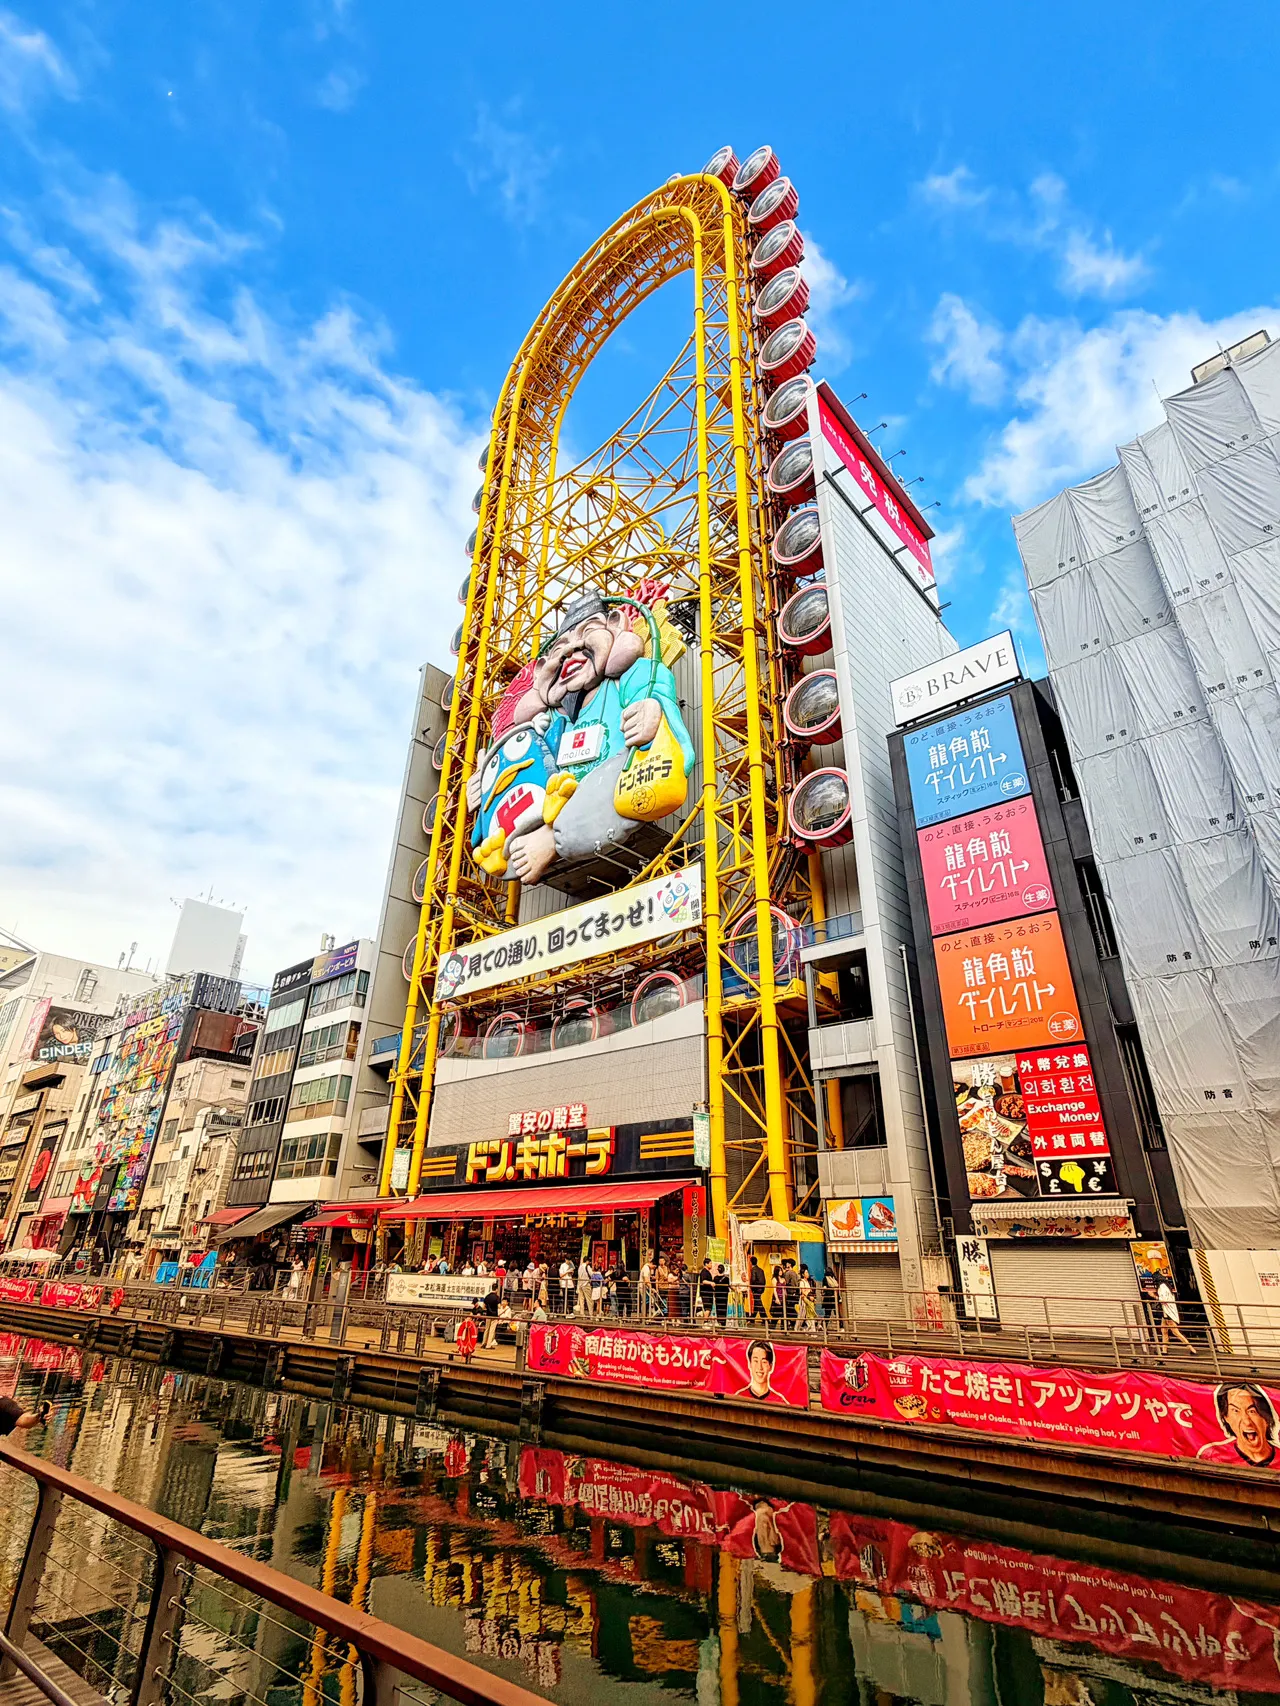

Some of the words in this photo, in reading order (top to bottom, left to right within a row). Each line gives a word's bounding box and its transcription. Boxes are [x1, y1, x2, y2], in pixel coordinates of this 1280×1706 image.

[858, 460, 902, 529] 免税
[926, 648, 1009, 696] BRAVE
[1237, 669, 1263, 684] 防音
[1207, 683, 1226, 694] 防音
[1173, 706, 1197, 718] 防音
[911, 702, 1006, 744] のど、直接、うるおう
[1106, 729, 1127, 742] 防音
[929, 726, 991, 769] 龍角散
[925, 752, 1008, 795] ダイレクト
[1002, 777, 1024, 791] 生薬
[937, 789, 969, 805] スティック
[925, 805, 1027, 842] のど、直接、うるおう
[1209, 813, 1235, 826] 防音
[1134, 833, 1158, 845] 防音
[944, 829, 1013, 871] 龍角散
[940, 858, 1030, 900] ダイレクト
[955, 897, 989, 911] スティック
[1025, 889, 1048, 903] 生薬
[467, 898, 653, 978] 見ての通り、回ってまっせ!
[941, 920, 1052, 952] のど、直接、うるおう
[1249, 936, 1277, 949] 防音
[1166, 951, 1192, 963] 防音
[962, 946, 1036, 987] 龍角散
[958, 980, 1055, 1020] ダイレクト
[973, 1021, 1005, 1033] トローチ
[1050, 1019, 1076, 1033] 生薬
[40, 1042, 92, 1059] CINDER
[952, 1042, 990, 1056] 第3類医薬品
[1020, 1053, 1089, 1074] 外幣兌換
[972, 1063, 997, 1087] 勝
[1024, 1074, 1094, 1097] 외화환전
[1204, 1089, 1233, 1100] 防音
[1027, 1101, 1086, 1114] Exchange
[508, 1103, 586, 1136] 驚安の殿堂
[1059, 1111, 1100, 1123] Money
[1033, 1131, 1105, 1150] 外貨両替
[1040, 1162, 1052, 1177] $
[1093, 1161, 1107, 1175] ¥
[1049, 1179, 1061, 1193] £
[1088, 1177, 1102, 1191] €
[962, 1240, 985, 1263] 勝
[888, 1363, 912, 1375] 大阪と
[946, 1409, 978, 1421] Speaking
[980, 1413, 987, 1421] of
[1018, 1418, 1032, 1427] The
[1033, 1420, 1073, 1432] takoyaki's
[1075, 1425, 1100, 1437] piping
[1100, 1428, 1117, 1438] hot,
